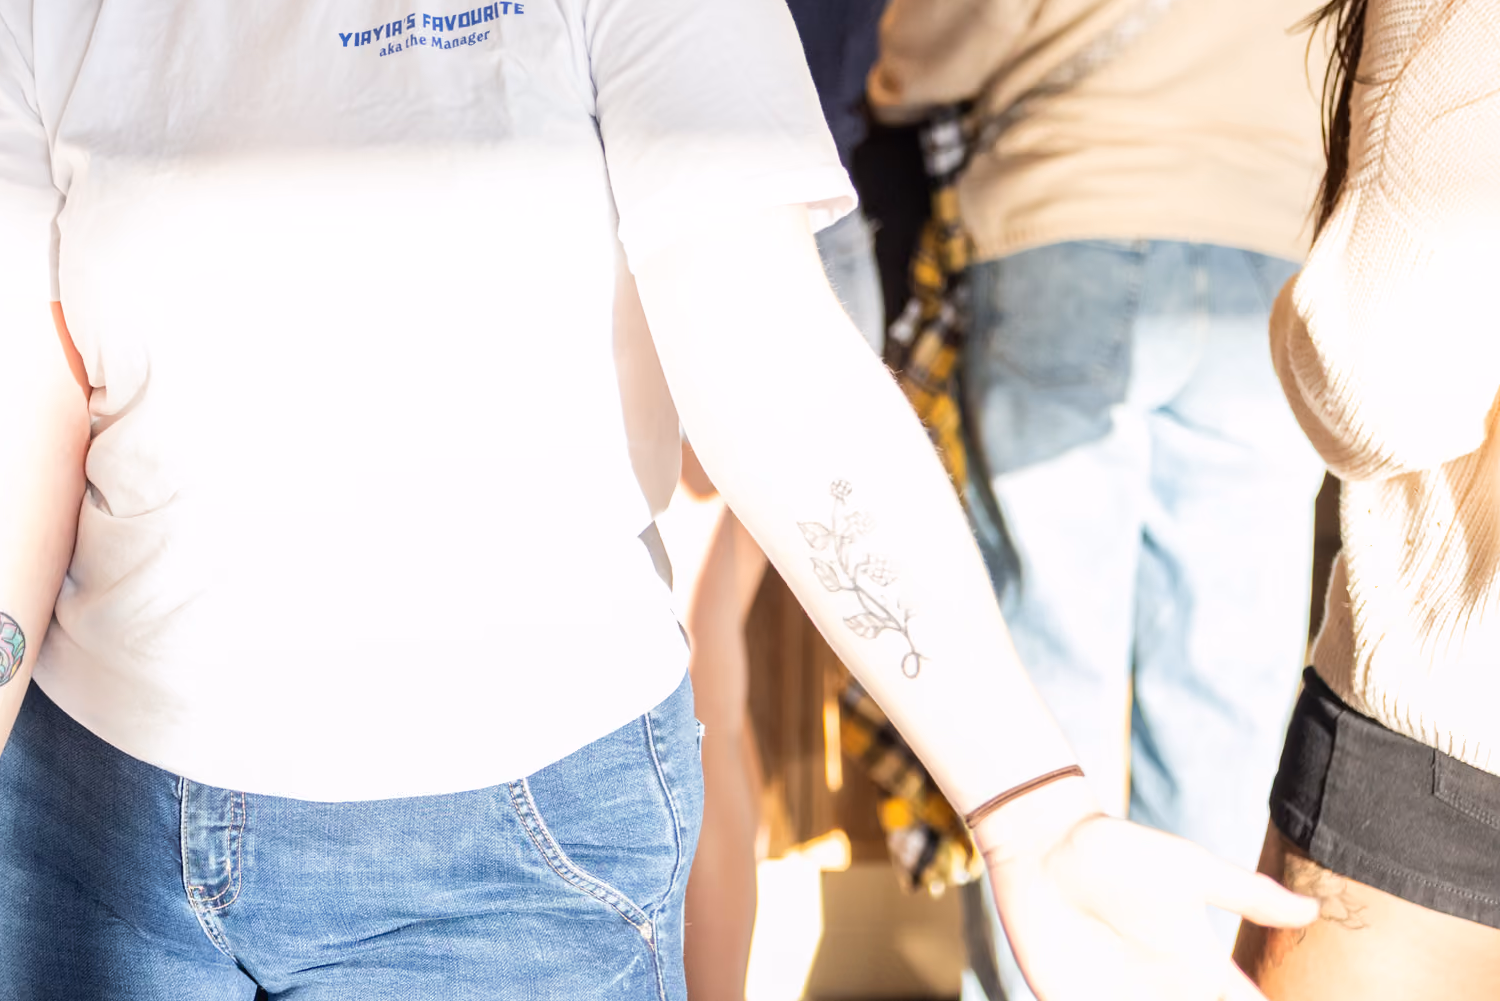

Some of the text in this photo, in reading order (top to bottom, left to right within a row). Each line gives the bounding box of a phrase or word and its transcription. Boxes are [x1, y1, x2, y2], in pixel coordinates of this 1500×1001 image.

[338, 0, 525, 48] YIAYIA'S FAVOURITE
[379, 29, 491, 57] aka the Manager
